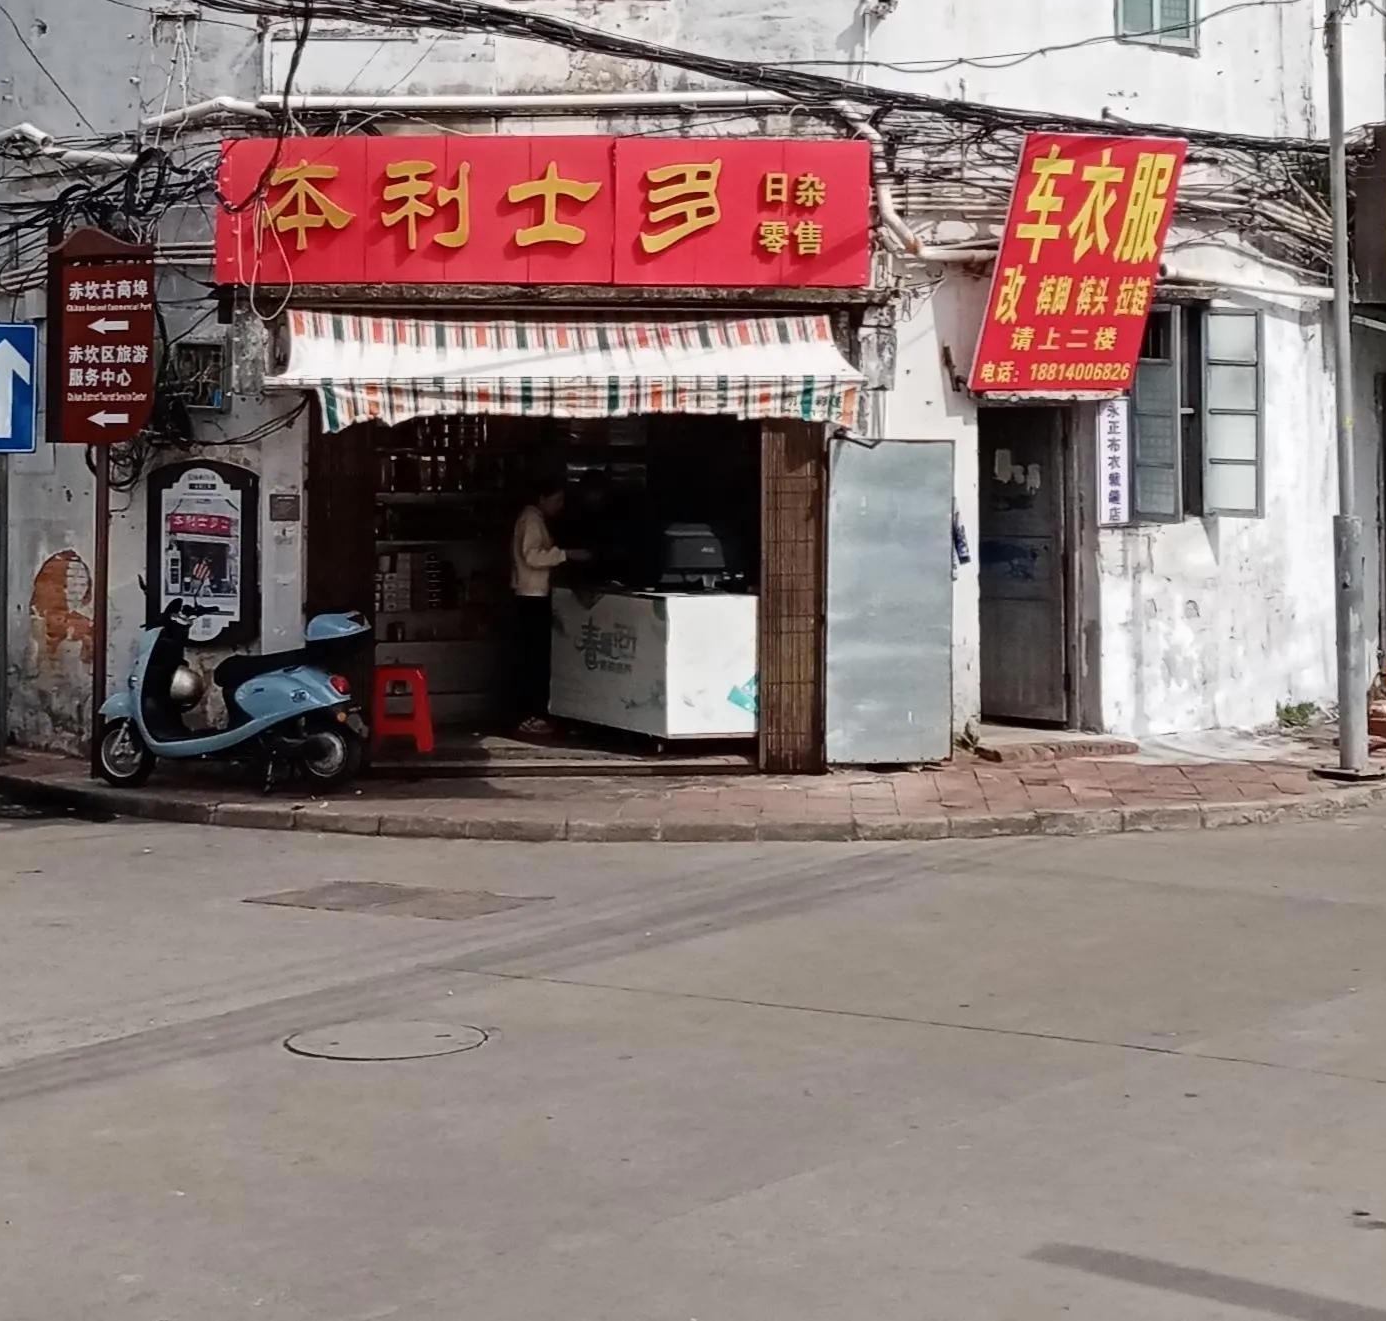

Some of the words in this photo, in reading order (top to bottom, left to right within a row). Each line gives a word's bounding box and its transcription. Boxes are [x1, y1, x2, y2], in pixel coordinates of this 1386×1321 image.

[763, 171, 827, 207] 日杂
[1016, 144, 1176, 264] 车衣服
[263, 158, 723, 255] 本利士多
[758, 220, 825, 256] 零售
[68, 279, 150, 301] 赤坎古商埠
[994, 263, 1027, 325] 改
[1010, 326, 1118, 351] 请上二楼
[68, 344, 150, 364] 赤坎区旅游
[68, 367, 133, 387] 服务中心
[1029, 362, 1132, 382] 18814006826
